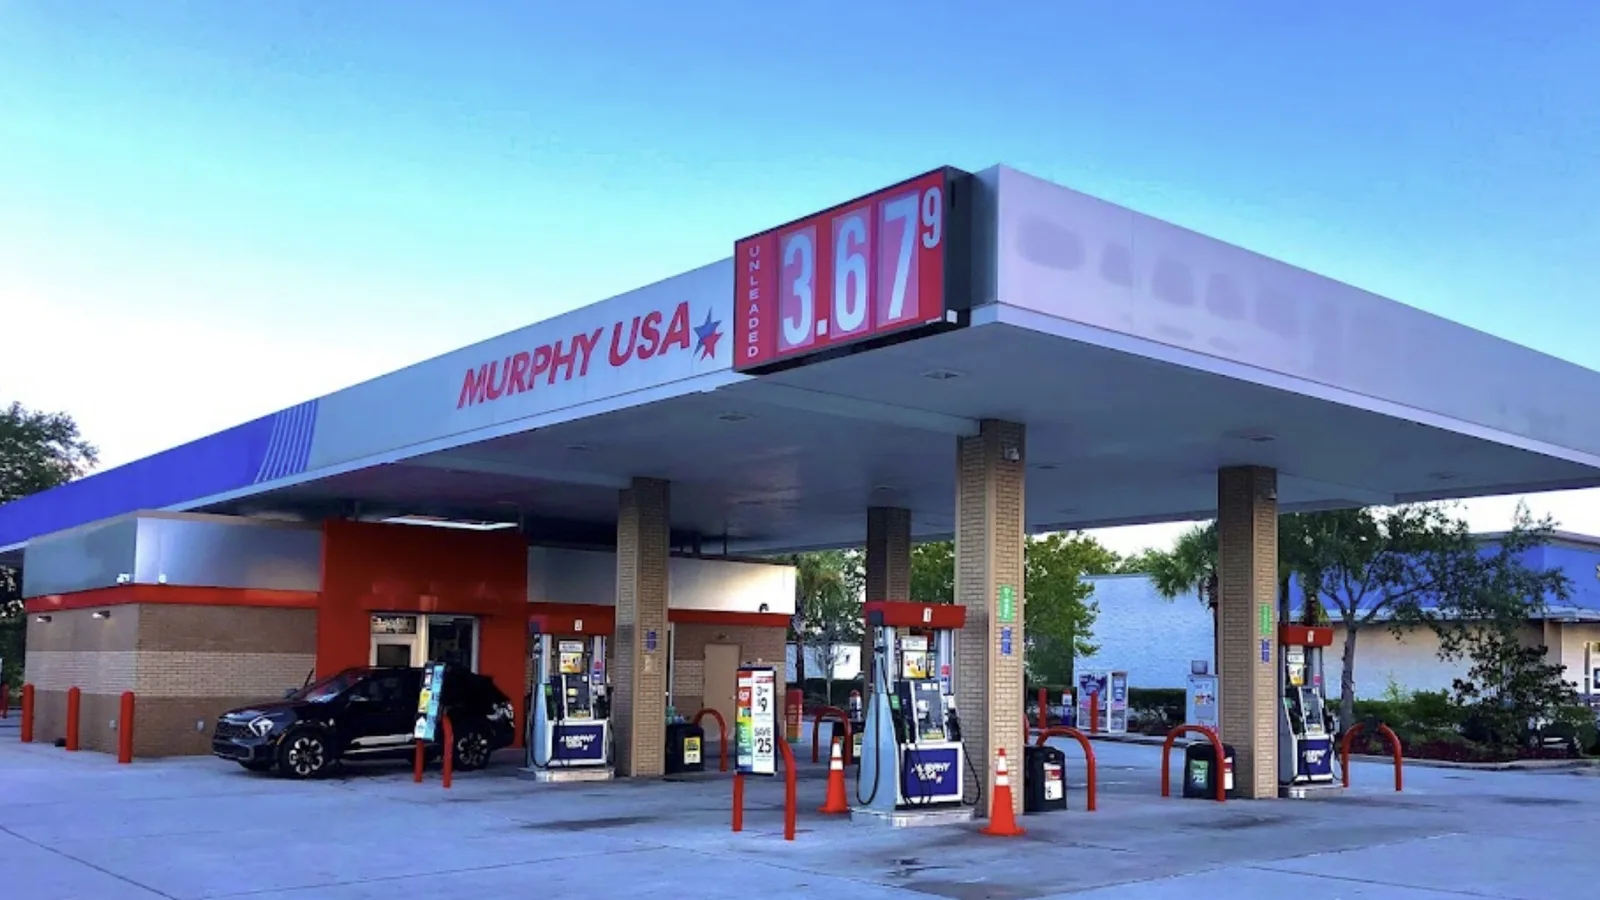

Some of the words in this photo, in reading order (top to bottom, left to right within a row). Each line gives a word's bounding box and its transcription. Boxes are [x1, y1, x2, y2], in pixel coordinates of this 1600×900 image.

[457, 327, 604, 409] MURPHY
[608, 301, 691, 367] USA
[747, 245, 760, 357] UNLEADED
[754, 726, 772, 737] SAVE
